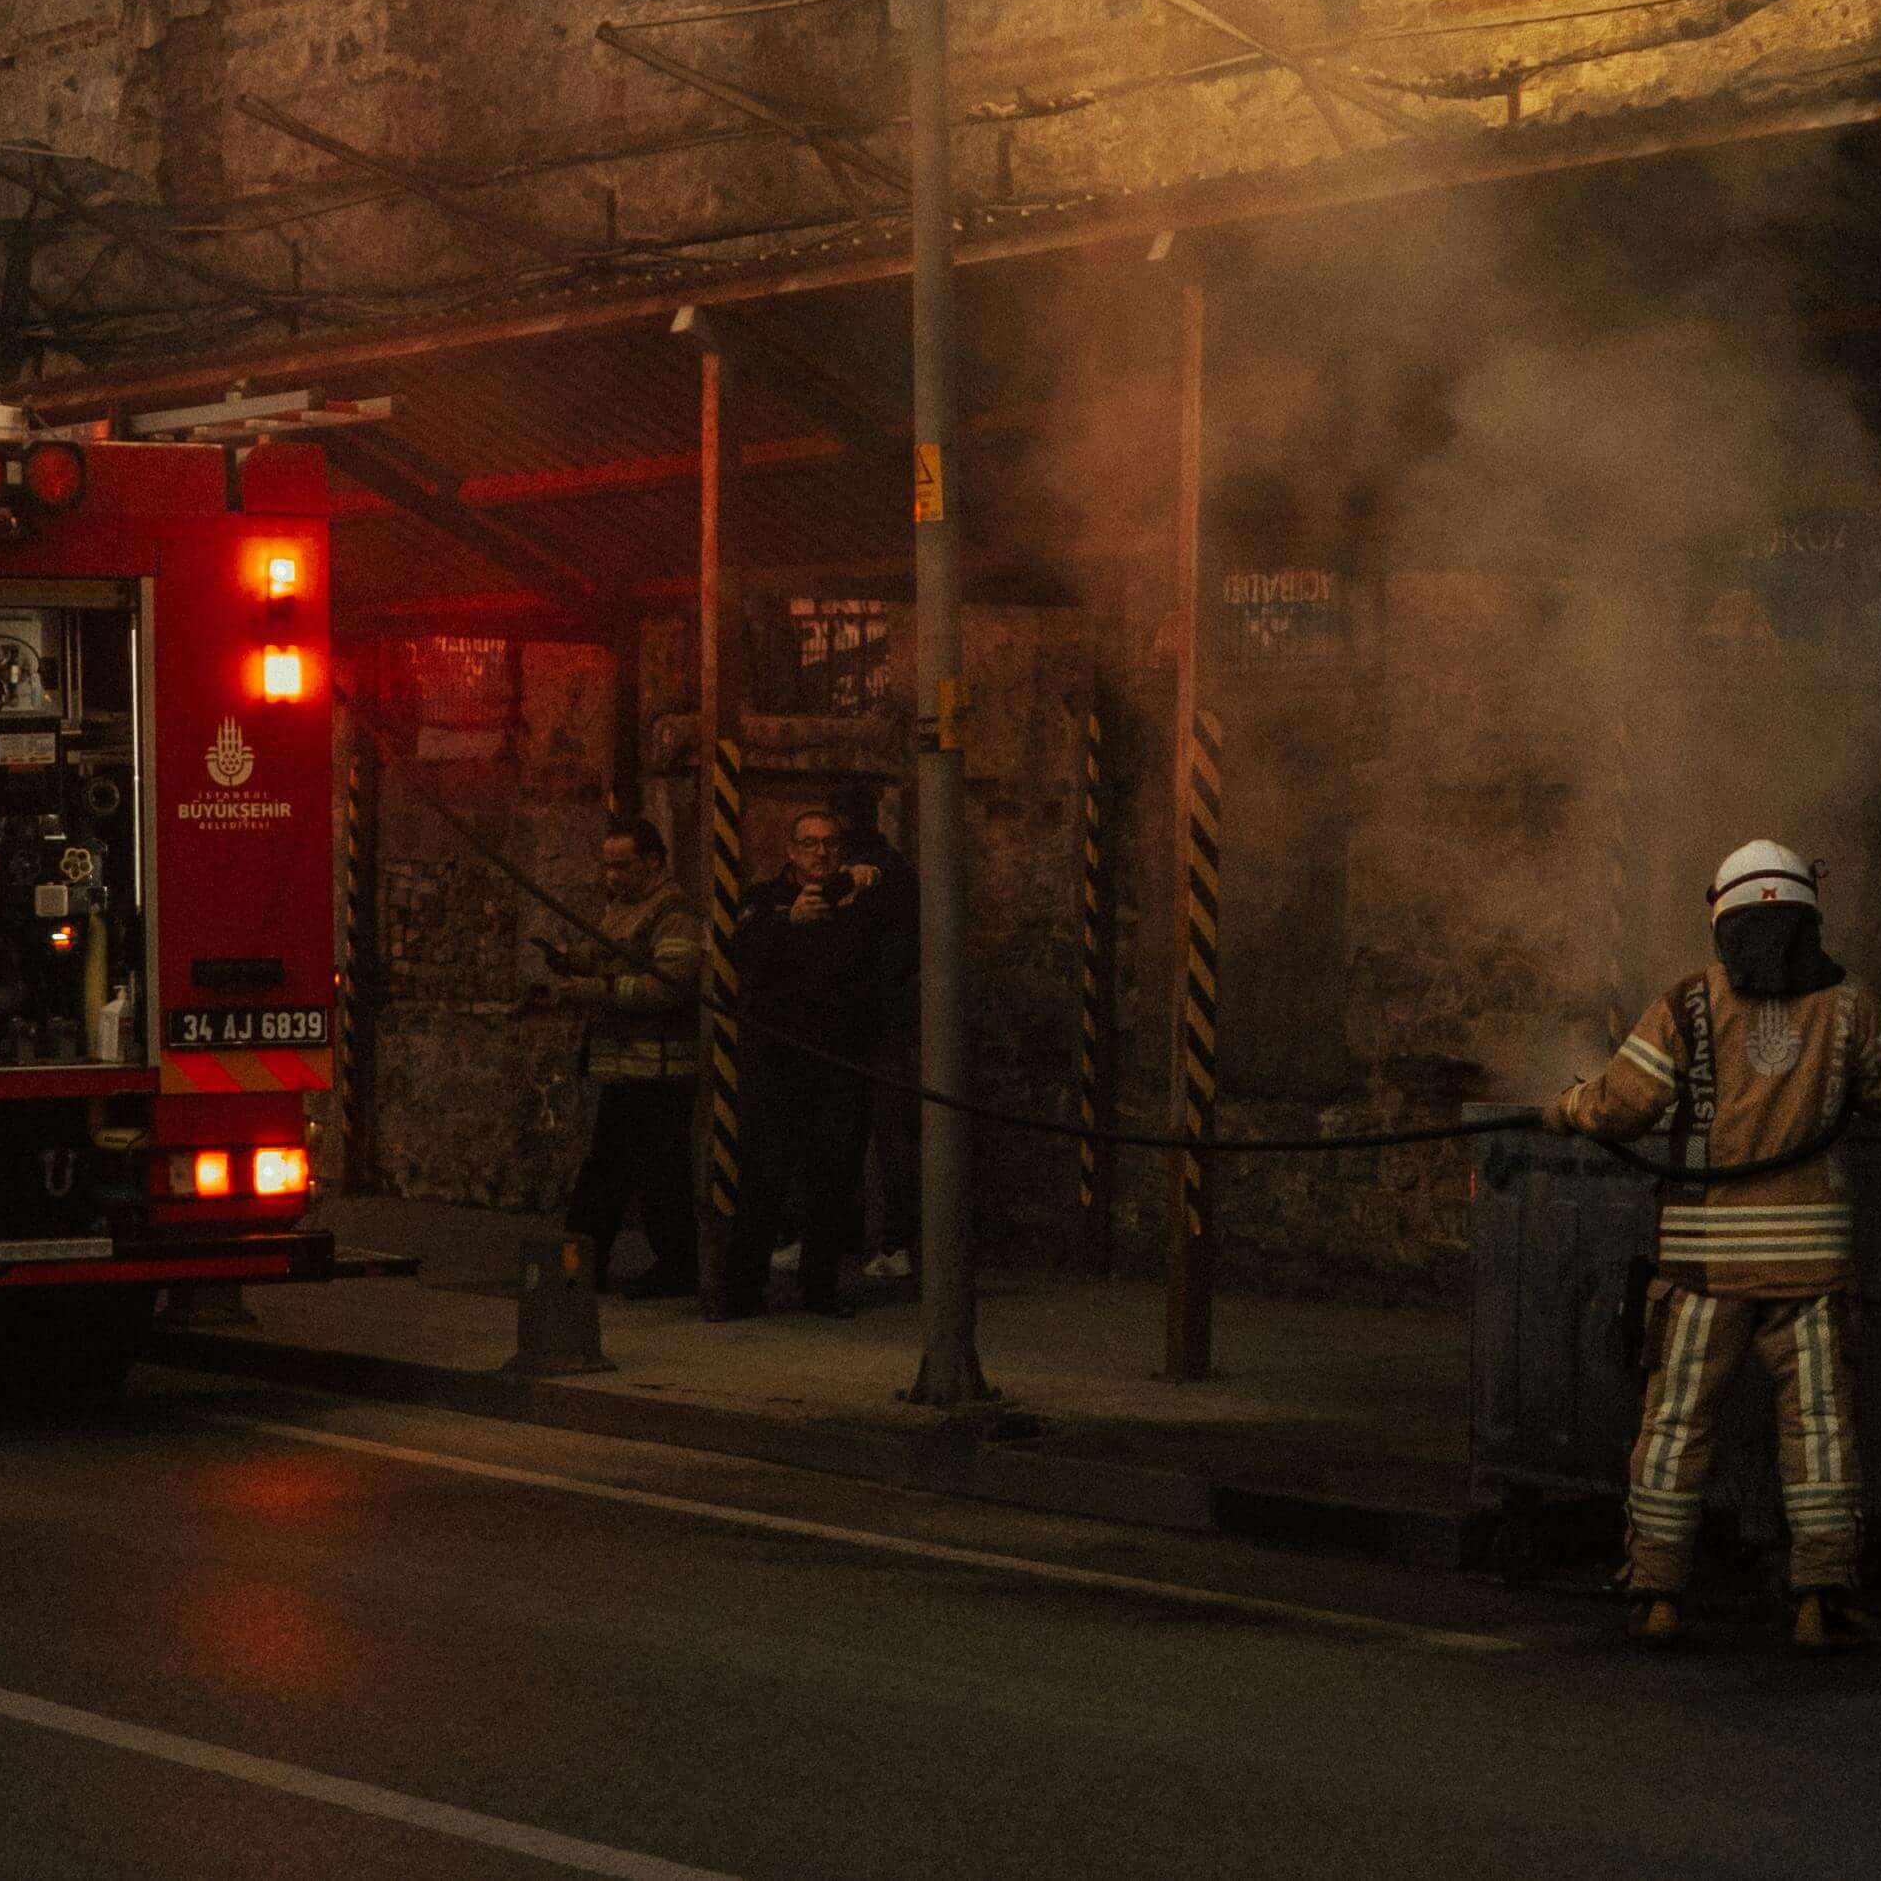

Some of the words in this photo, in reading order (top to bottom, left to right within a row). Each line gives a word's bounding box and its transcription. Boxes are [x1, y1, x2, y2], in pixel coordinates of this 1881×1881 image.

[178, 798, 292, 822] BÜYÜKŞEHİR
[183, 1014, 213, 1042] 34
[223, 1013, 252, 1040] AJ
[261, 1011, 322, 1039] 6839
